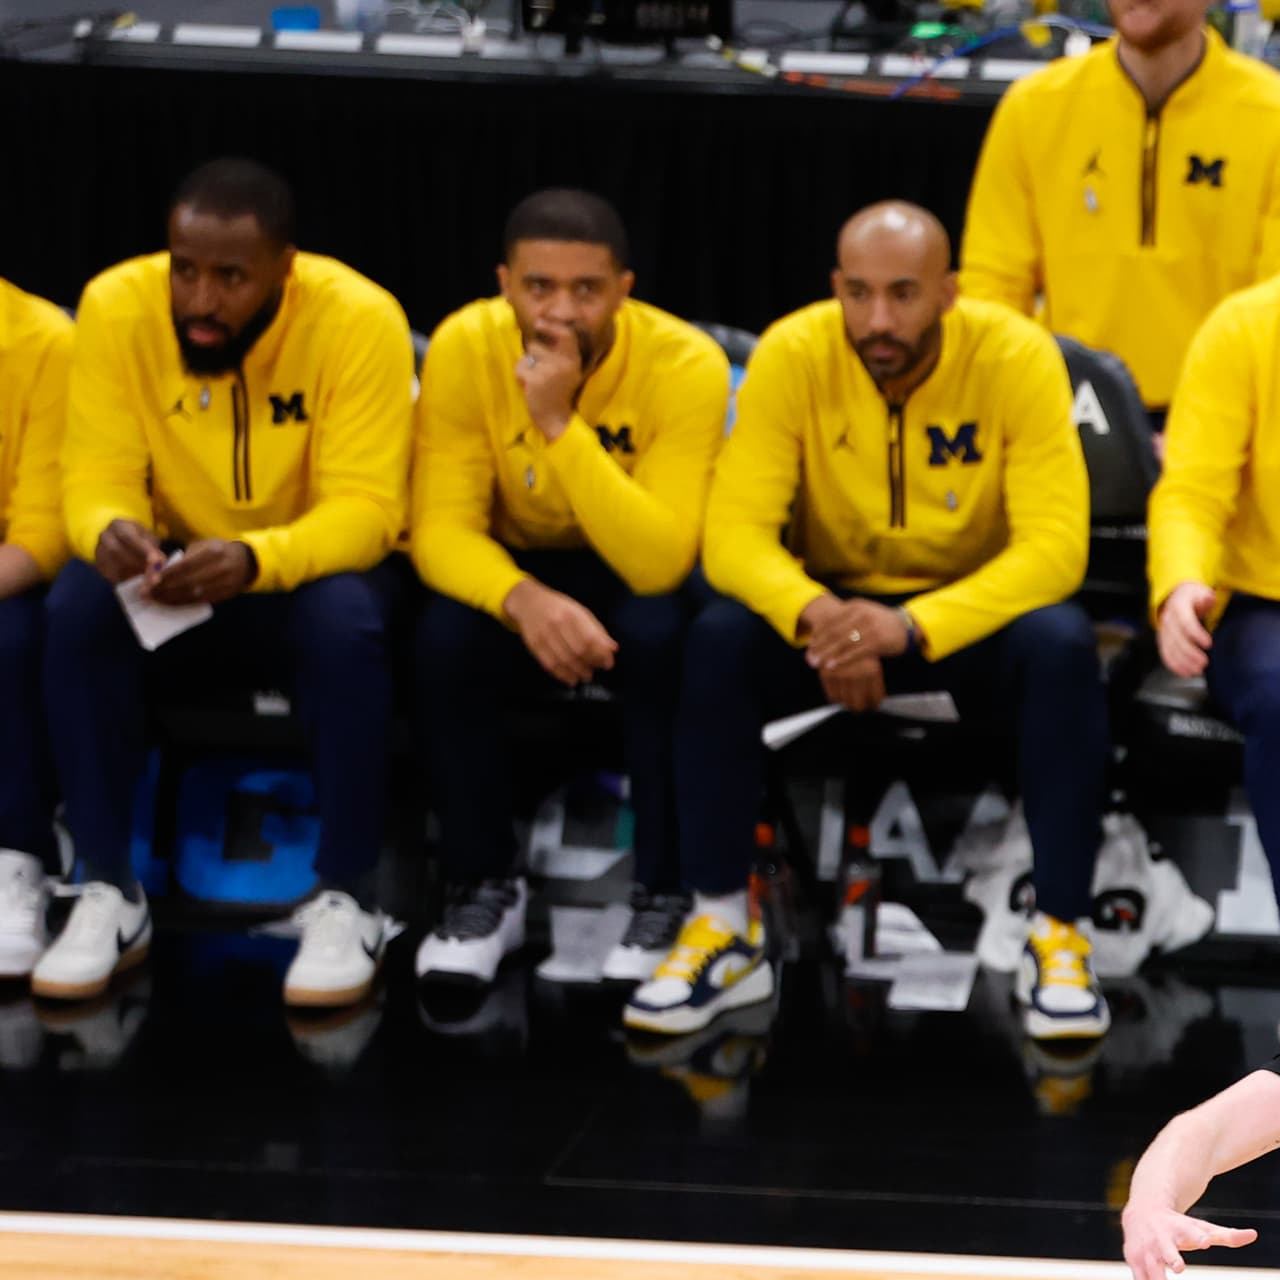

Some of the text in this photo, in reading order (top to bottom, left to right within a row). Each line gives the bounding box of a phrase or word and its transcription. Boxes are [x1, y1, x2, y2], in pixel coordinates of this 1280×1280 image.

[1186, 155, 1224, 187] M
[269, 391, 309, 425] M
[595, 424, 636, 454] M
[925, 421, 982, 467] M
